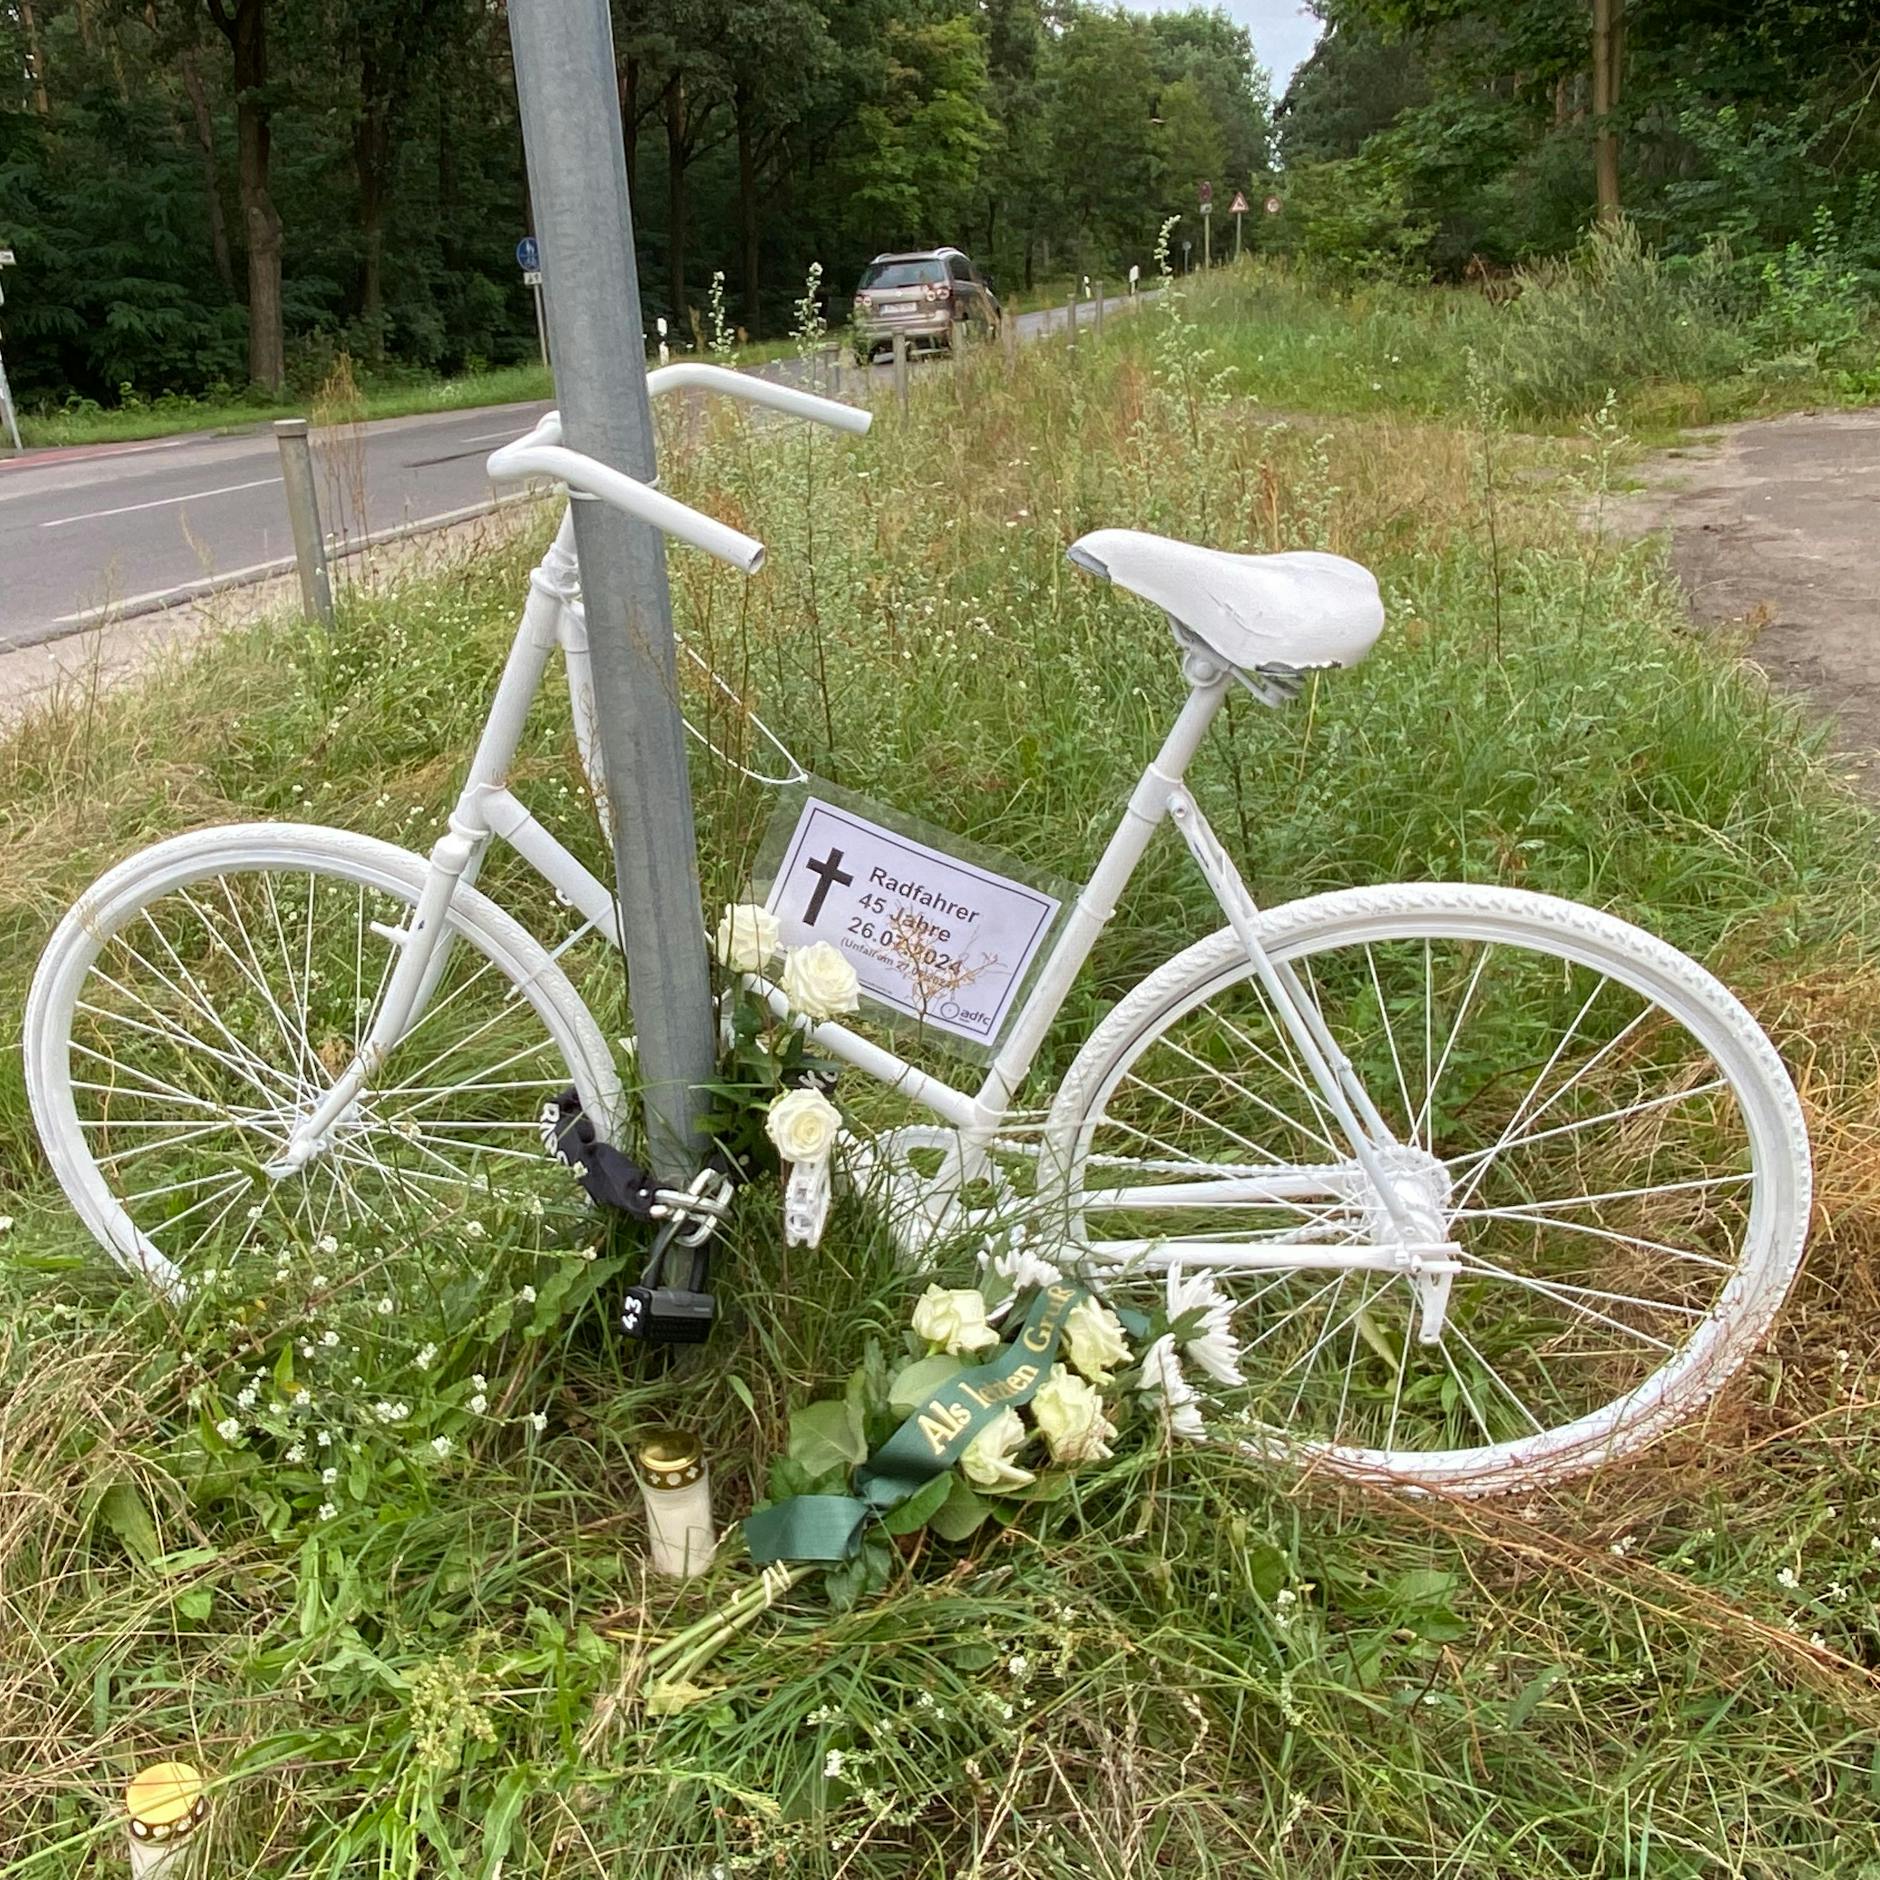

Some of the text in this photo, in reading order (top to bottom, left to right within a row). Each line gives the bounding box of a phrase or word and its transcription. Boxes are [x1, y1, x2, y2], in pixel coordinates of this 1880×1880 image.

[858, 893, 951, 942] 45 Jahre
[869, 866, 980, 923] Radfahrer
[847, 916, 963, 976] 26.0.2024
[959, 1007, 991, 1026] adfc
[917, 1400, 972, 1455] Als
